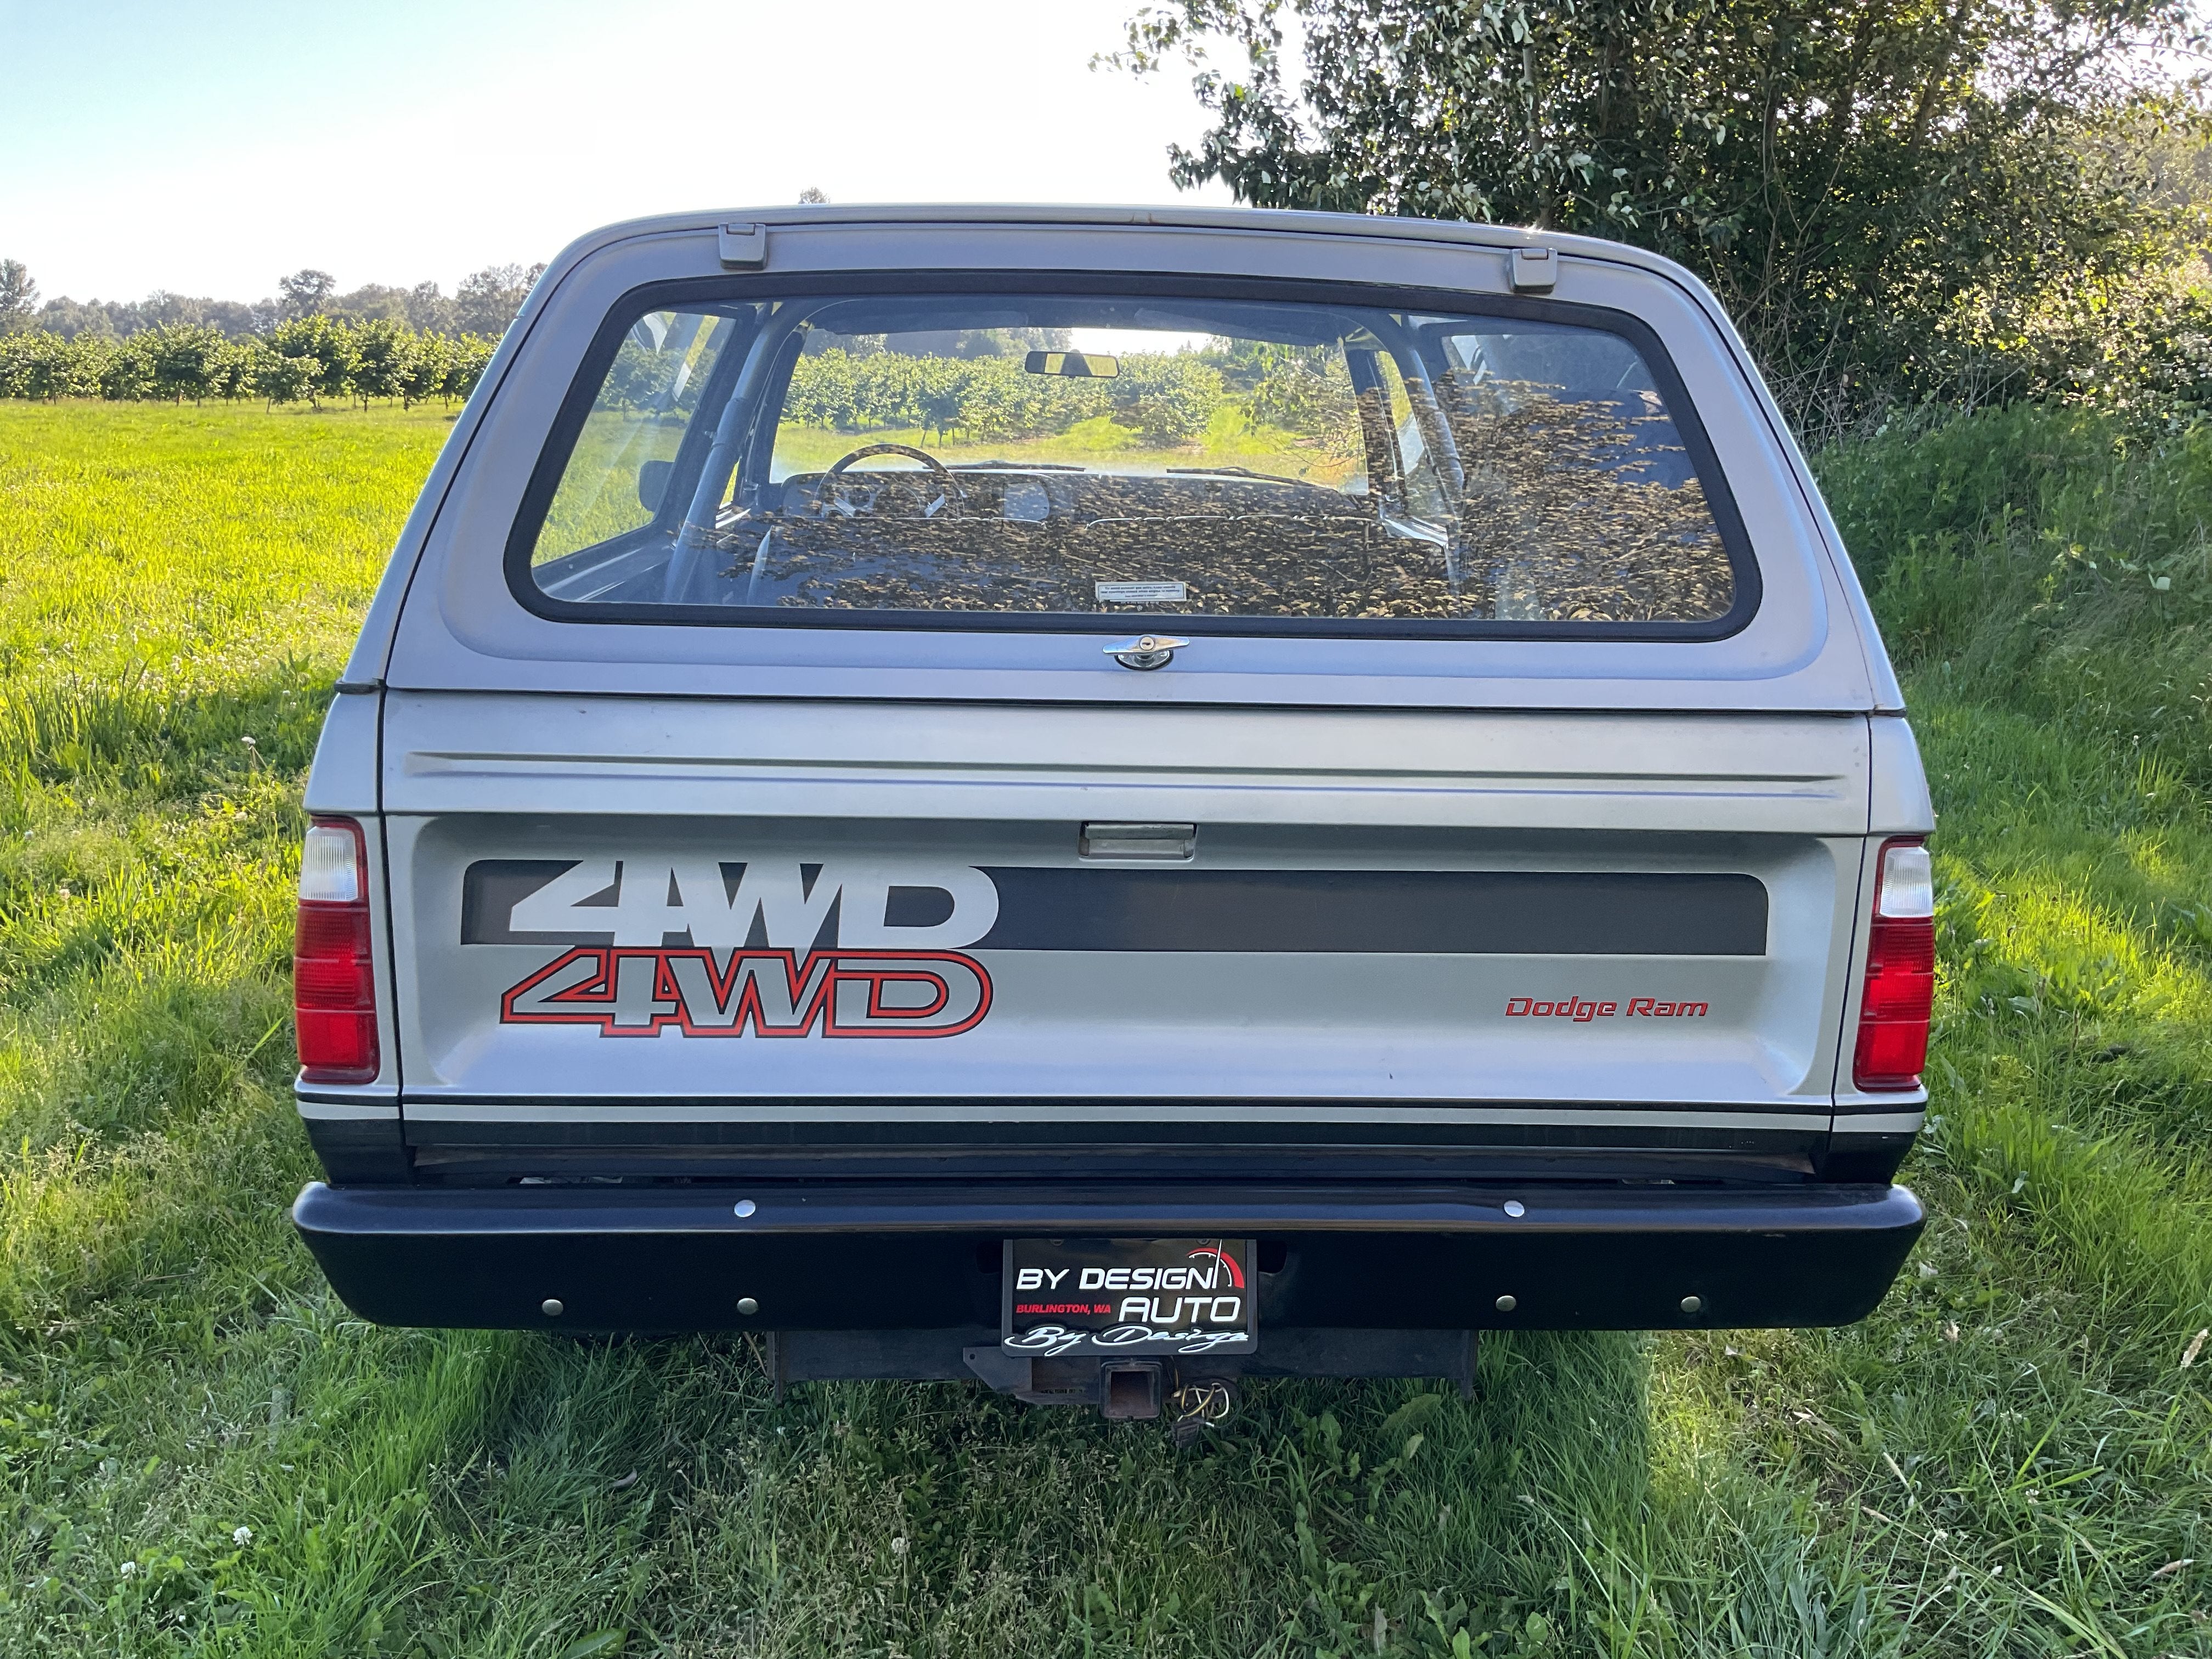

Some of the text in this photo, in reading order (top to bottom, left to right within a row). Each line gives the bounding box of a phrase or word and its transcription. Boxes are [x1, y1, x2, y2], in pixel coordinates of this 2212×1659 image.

[509, 860, 1000, 950] 4WD
[500, 946, 994, 1038] 4WD
[1505, 996, 1708, 1022] Dodge Ram
[1016, 1267, 1214, 1290] BY DESIGN
[1015, 1304, 1111, 1315] BURLINGTON, WA
[1118, 1296, 1241, 1323] AUTO
[1004, 1325, 1249, 1357] By Design
